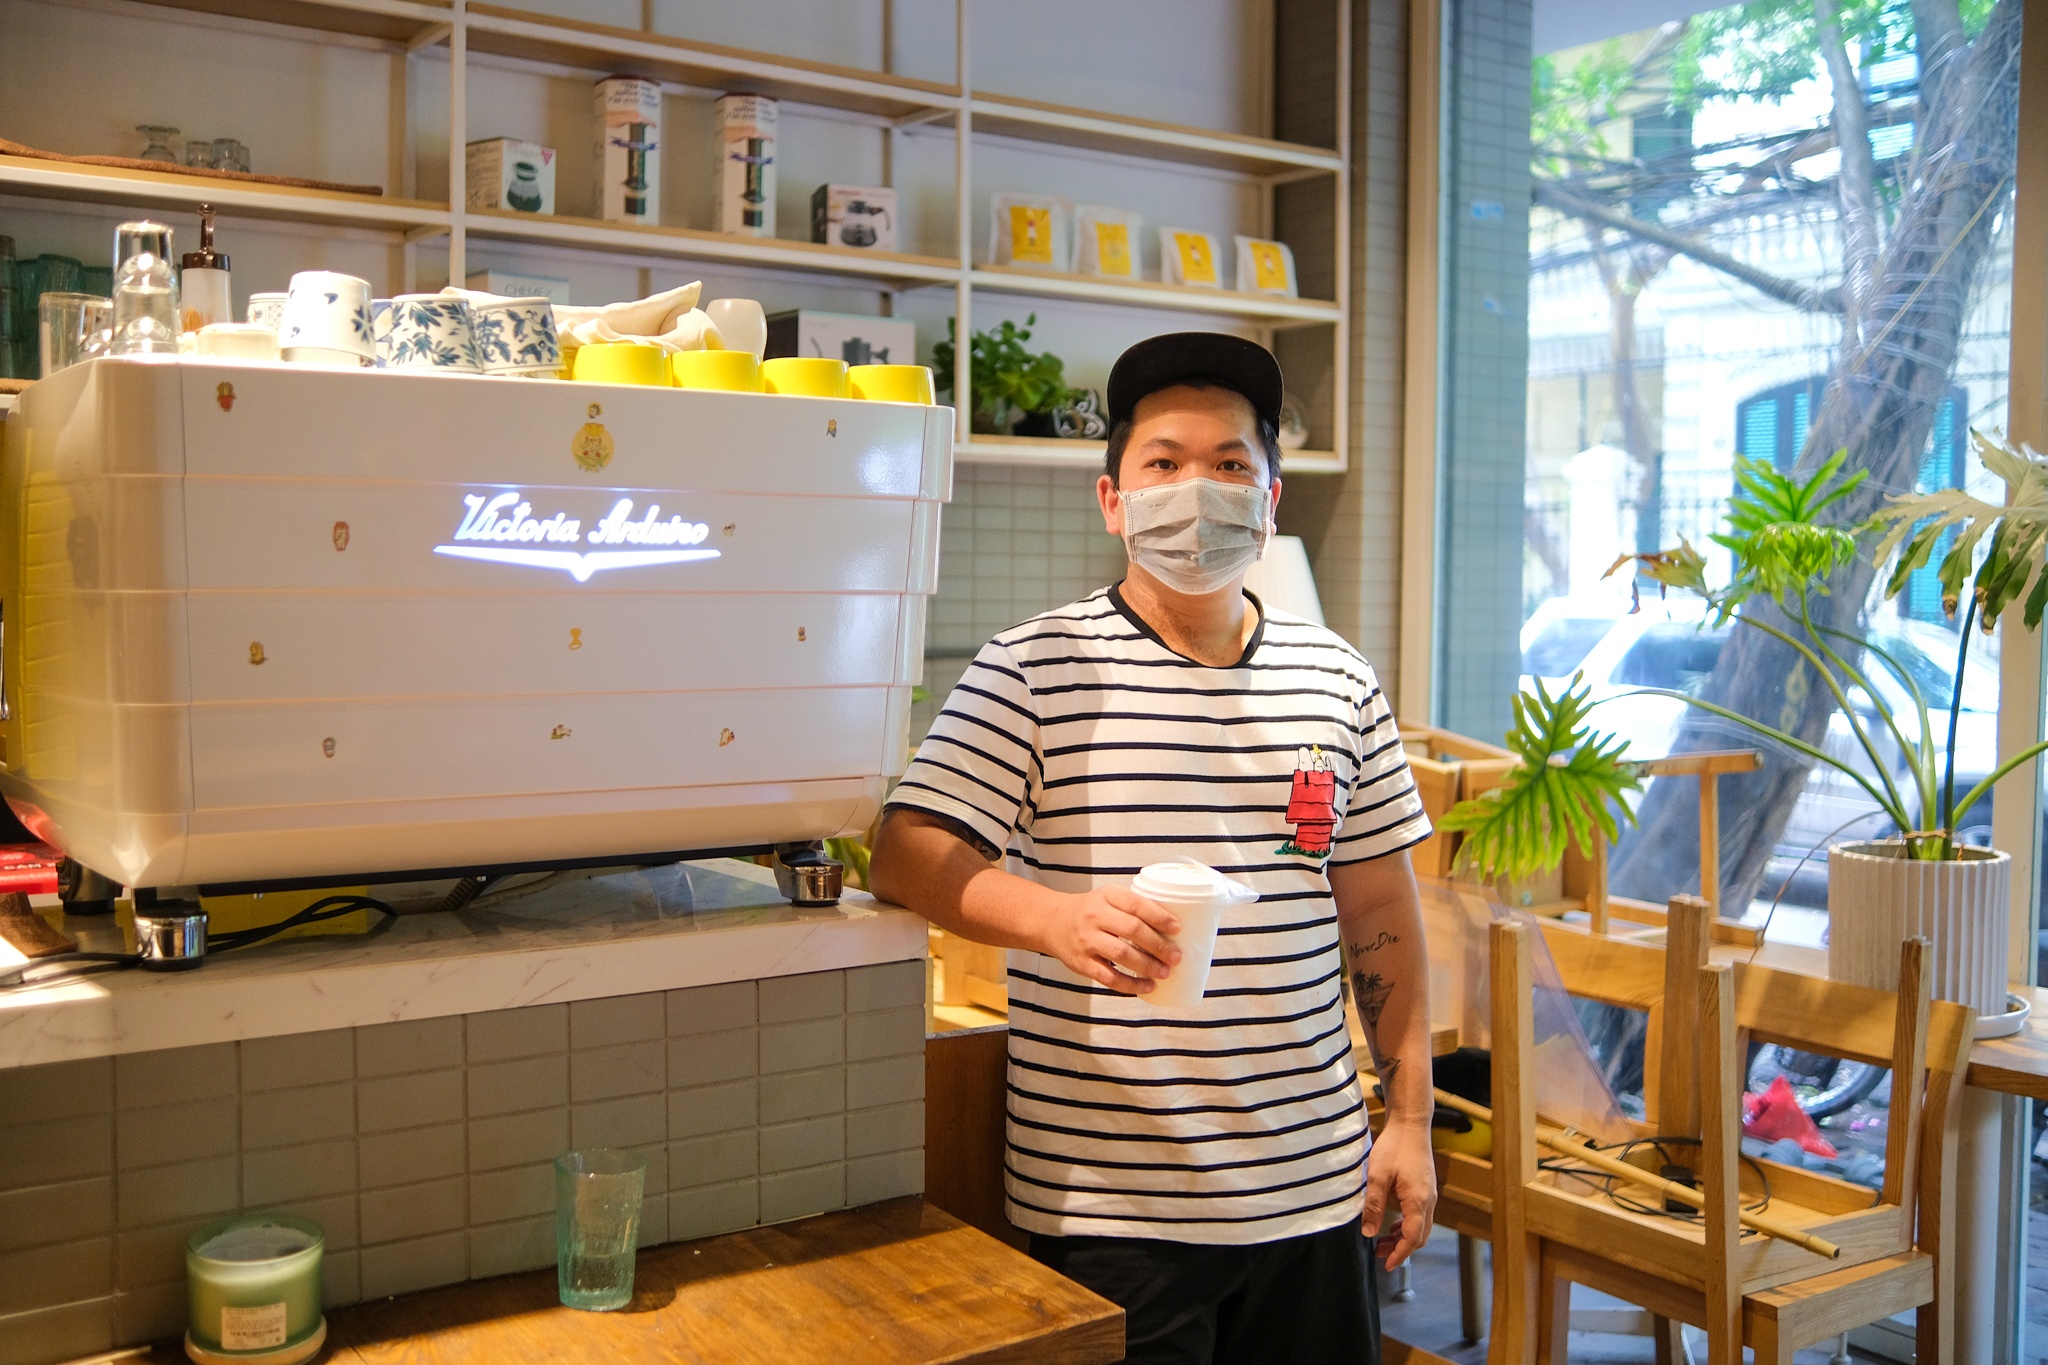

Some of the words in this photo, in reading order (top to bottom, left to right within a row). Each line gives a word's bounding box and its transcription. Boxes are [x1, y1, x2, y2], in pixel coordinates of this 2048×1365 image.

[454, 492, 581, 543] Victoria
[587, 498, 710, 545] Arduino
[1349, 942, 1375, 958] Never
[1374, 931, 1401, 951] Die
